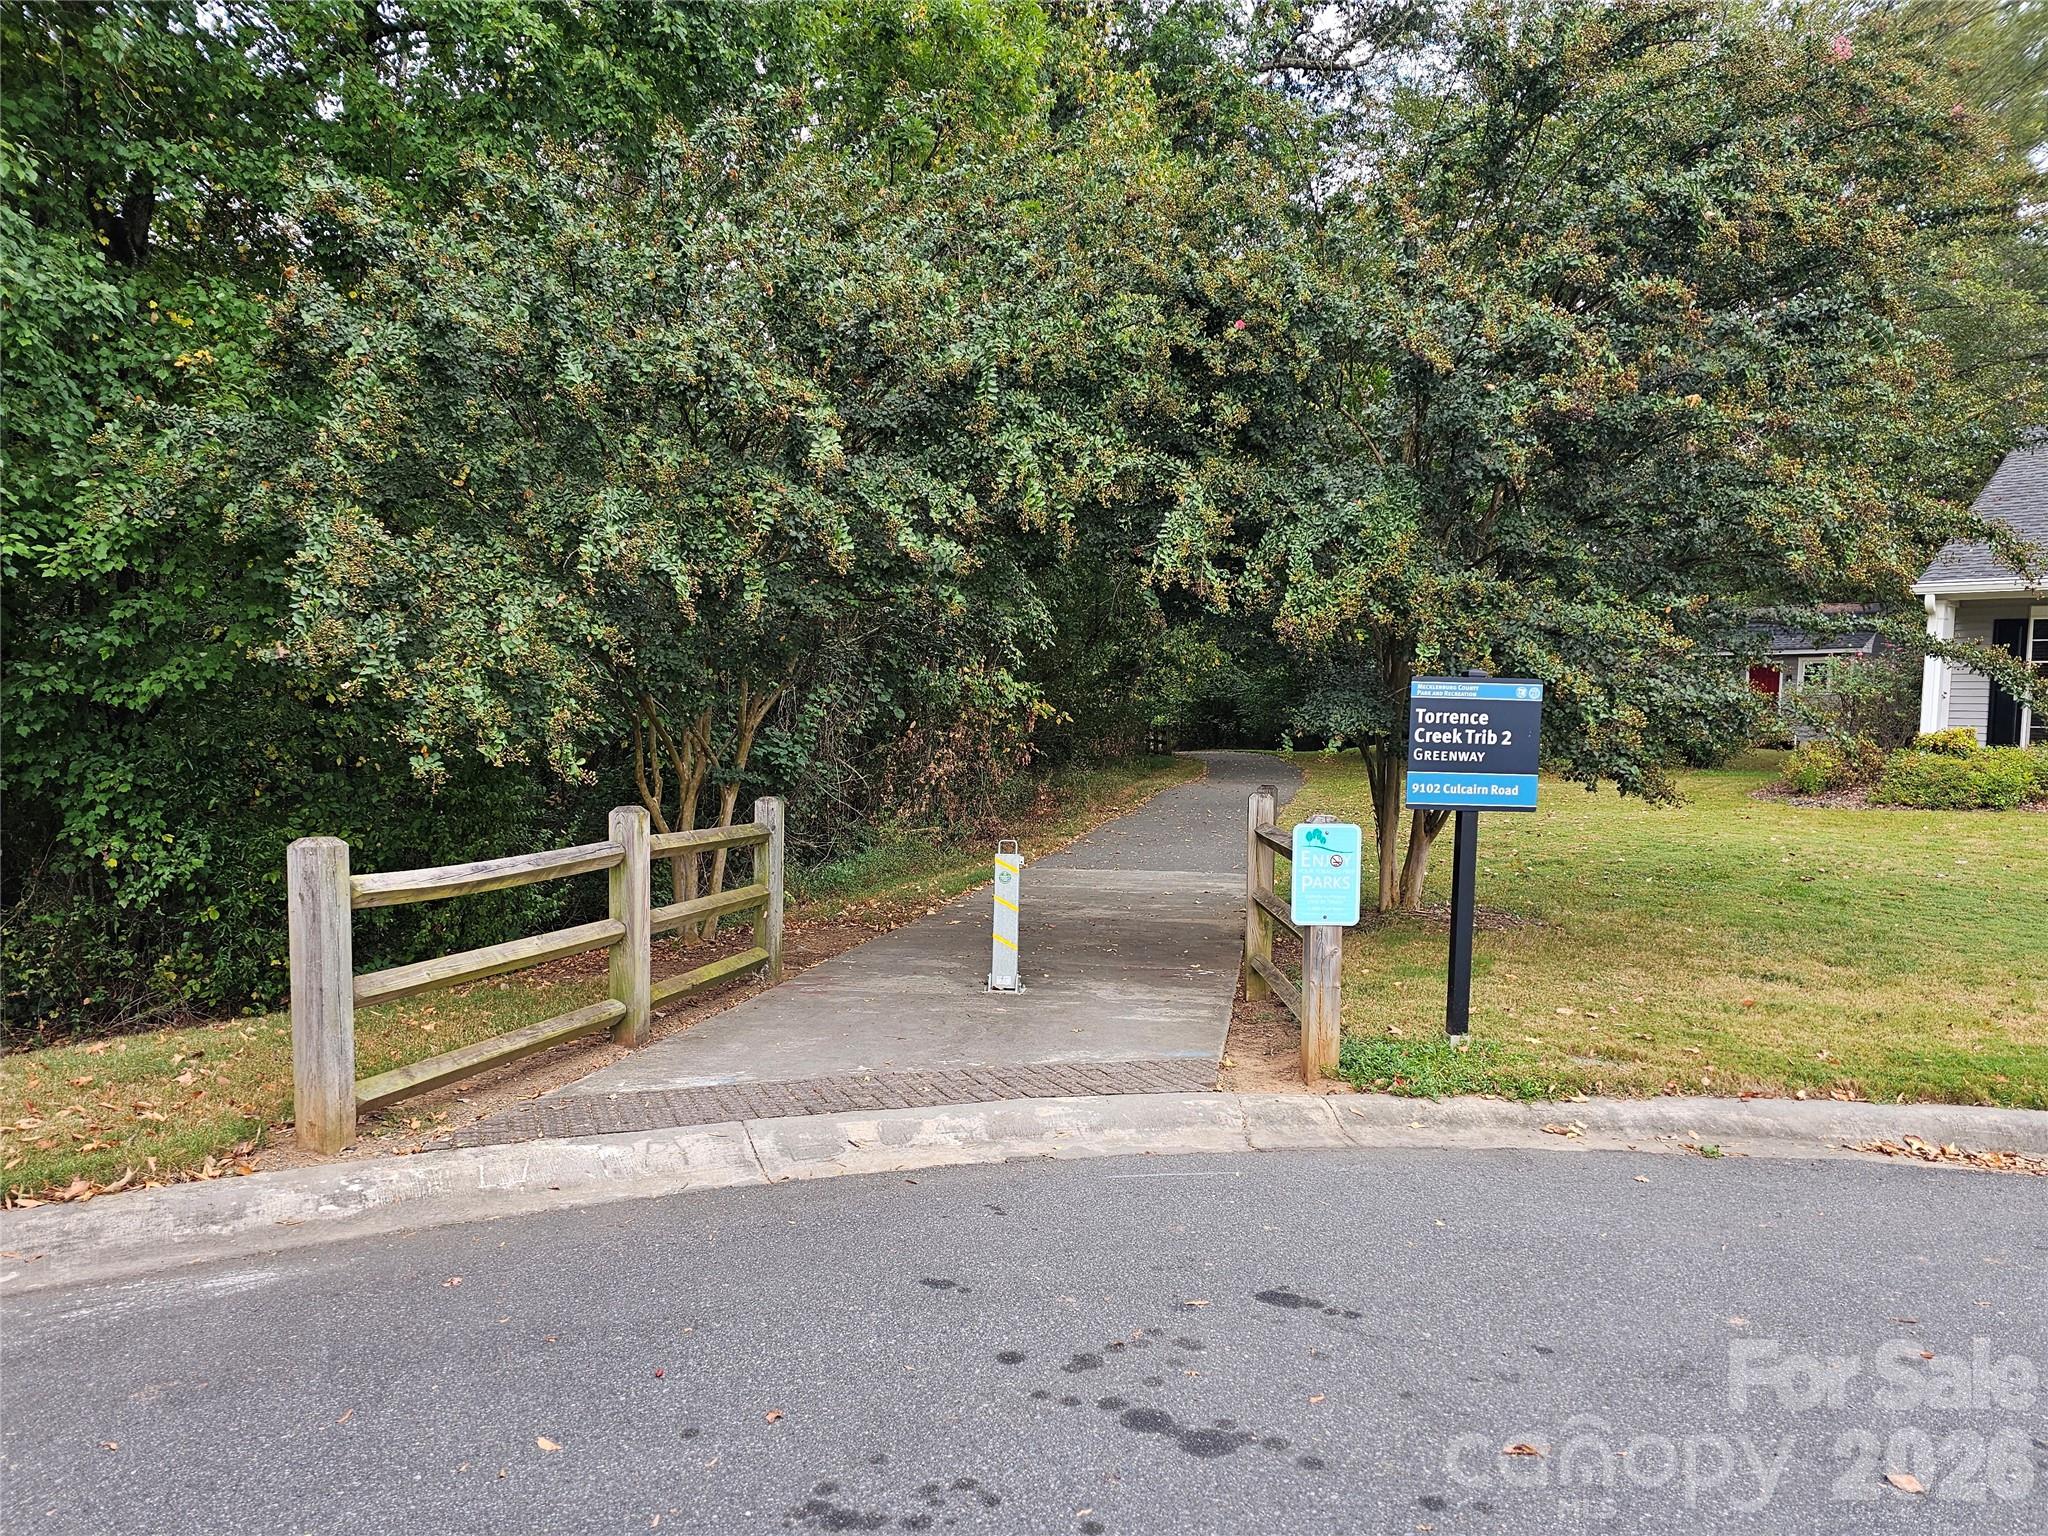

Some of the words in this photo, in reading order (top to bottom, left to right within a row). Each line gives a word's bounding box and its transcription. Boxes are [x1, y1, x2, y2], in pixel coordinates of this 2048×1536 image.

[1415, 708, 1489, 725] Torrence
[1414, 728, 1463, 744] Creek
[1465, 729, 1498, 745] Trib
[1501, 731, 1512, 746] 2
[1413, 748, 1486, 762] GREENWAY
[1412, 783, 1441, 794] 9102
[1443, 784, 1489, 795] Culcairn
[1490, 784, 1519, 796] Road
[1301, 875, 1351, 893] PARKS
